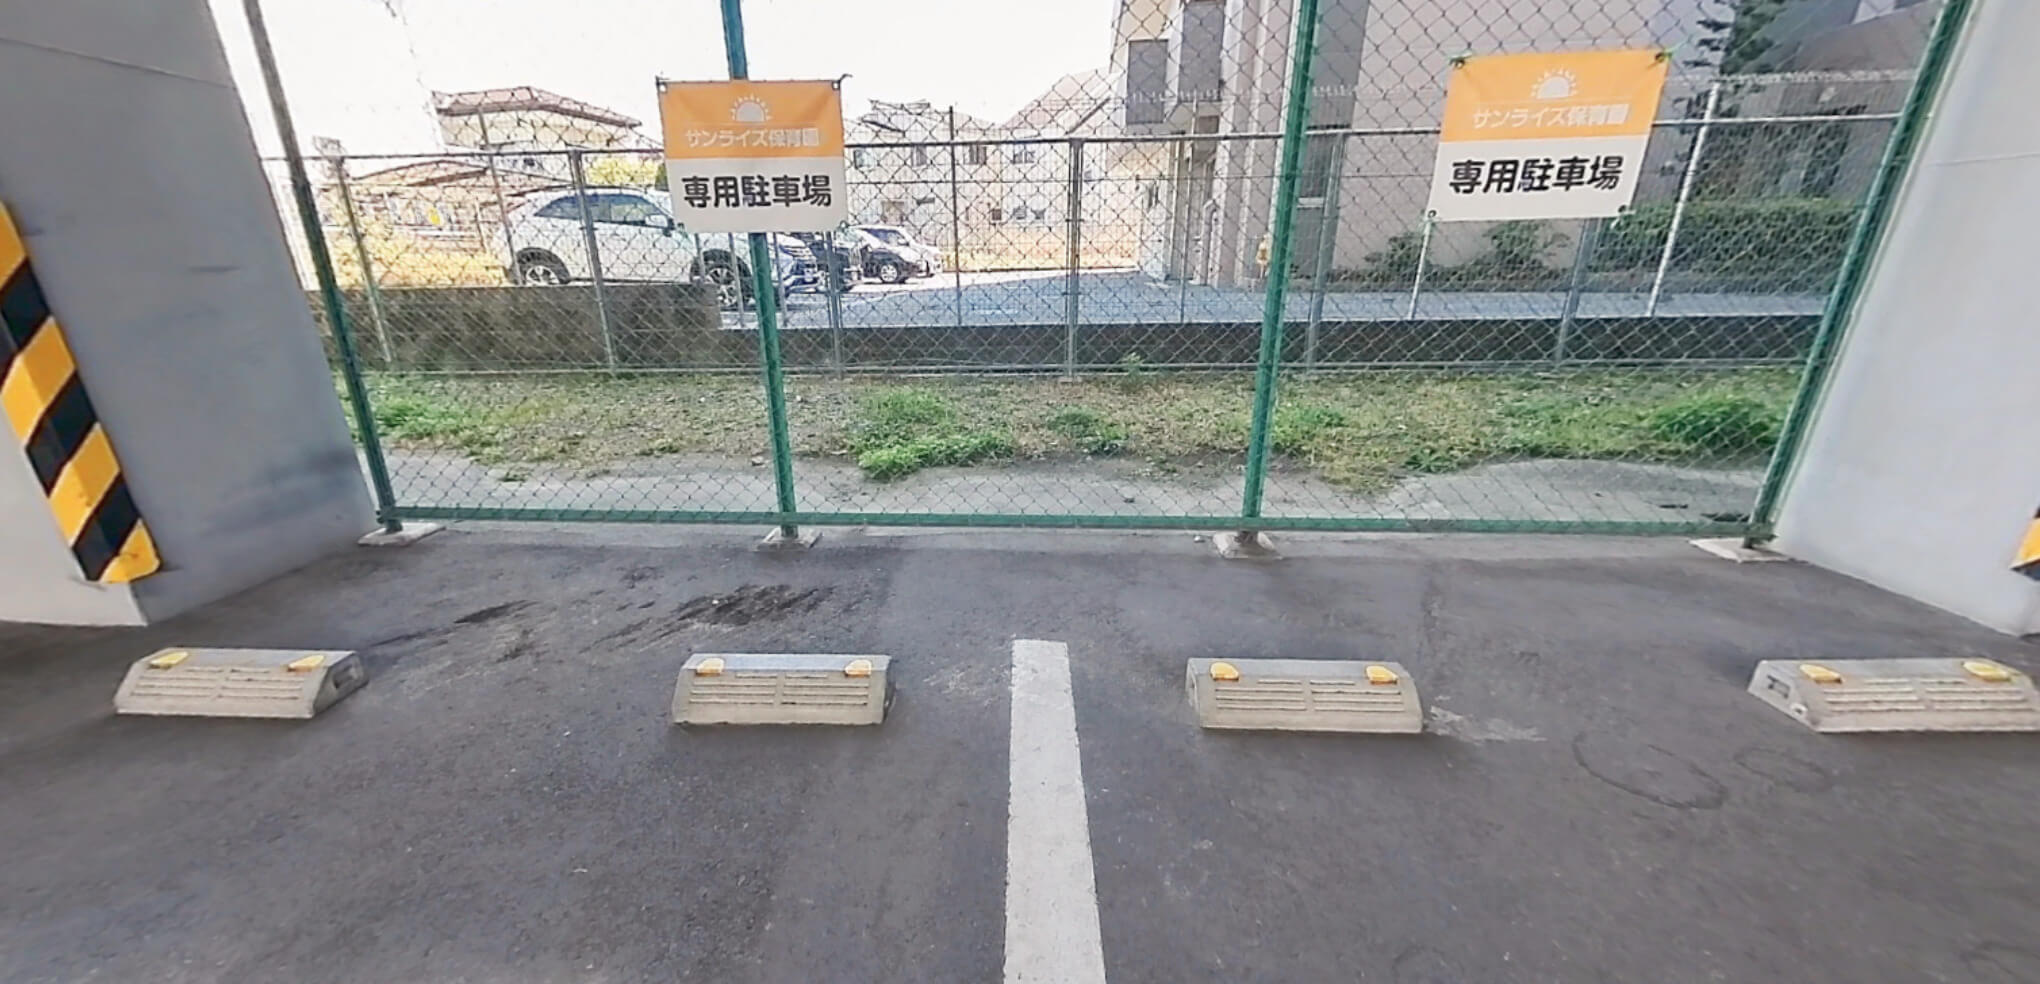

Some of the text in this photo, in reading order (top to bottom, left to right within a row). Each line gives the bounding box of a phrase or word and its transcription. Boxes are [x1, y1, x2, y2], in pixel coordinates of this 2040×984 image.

[681, 174, 832, 209] 専用駐車場
[1449, 155, 1624, 194] 専用駐車場
